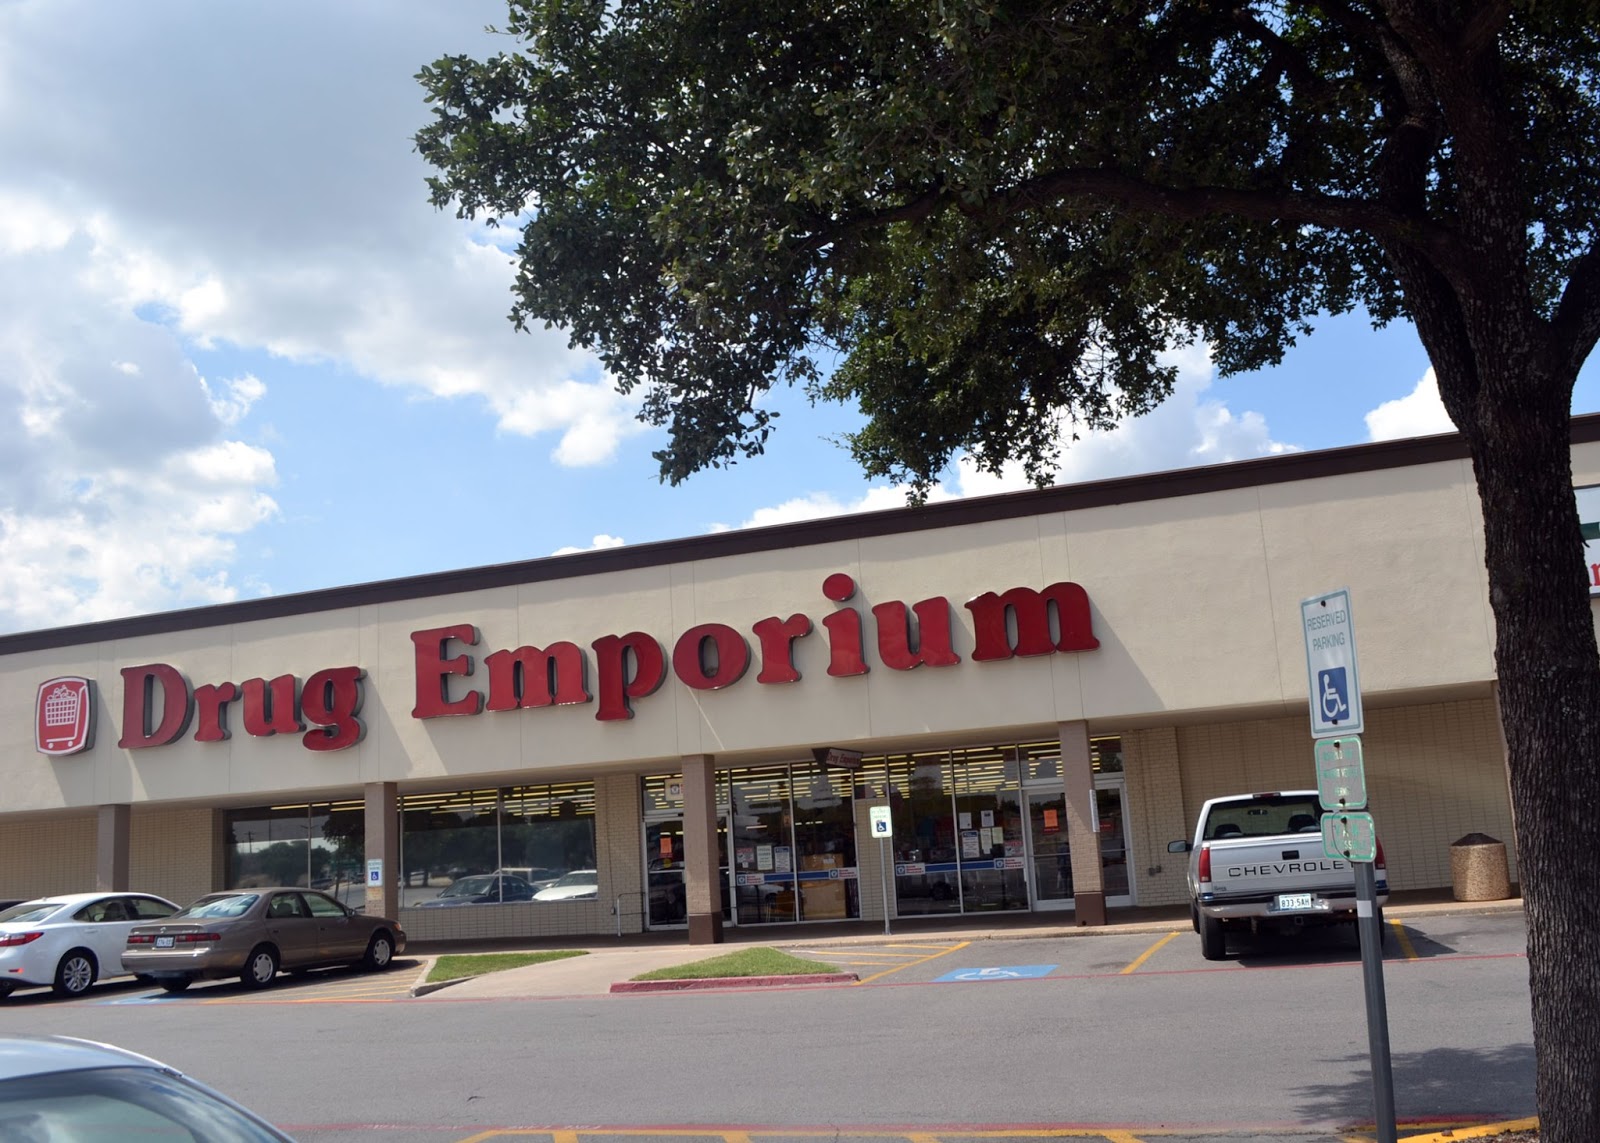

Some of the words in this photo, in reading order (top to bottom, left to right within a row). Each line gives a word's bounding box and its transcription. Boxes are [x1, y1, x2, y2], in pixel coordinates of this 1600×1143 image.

[1306, 610, 1347, 632] RESERVED
[1312, 632, 1345, 651] PARKING
[118, 662, 368, 752] Drug
[411, 573, 1100, 721] Emporium
[1228, 860, 1354, 877] CHEVROLE
